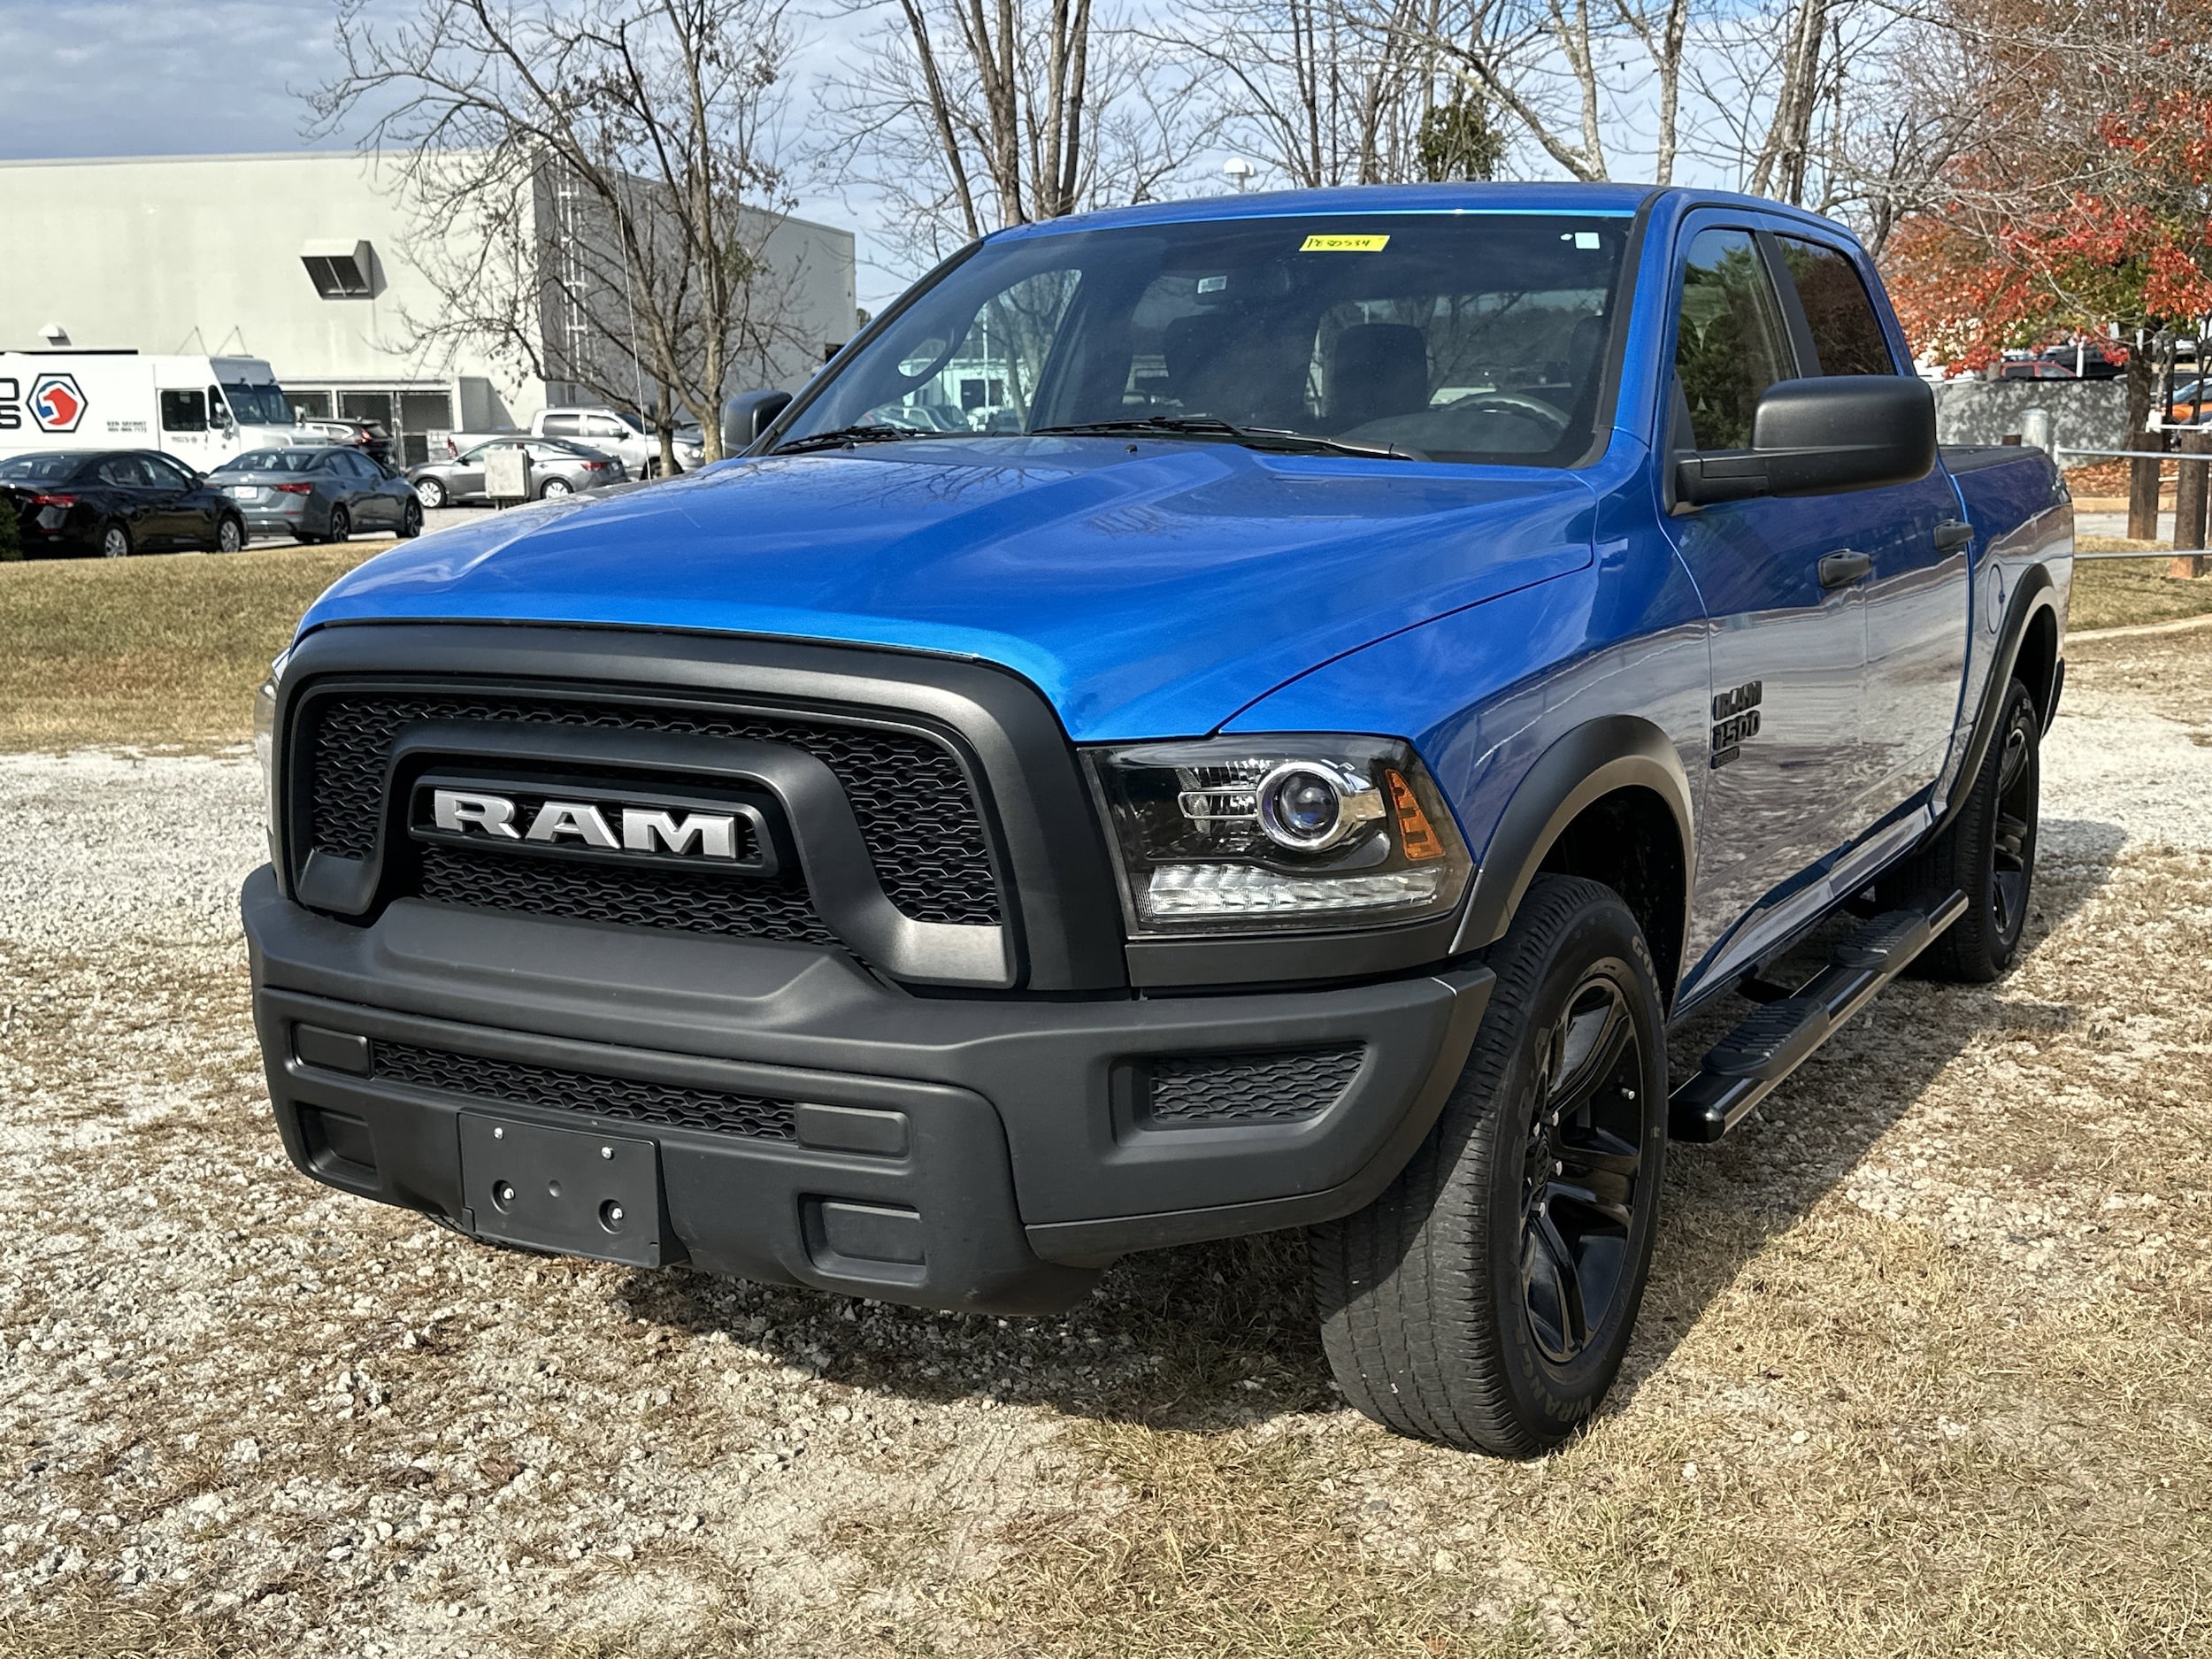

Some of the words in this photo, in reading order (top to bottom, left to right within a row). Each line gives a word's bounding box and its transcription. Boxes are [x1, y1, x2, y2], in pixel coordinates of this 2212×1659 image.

[1713, 680, 1763, 721] RAM
[1712, 710, 1761, 750] 1500
[434, 789, 738, 861] RAM
